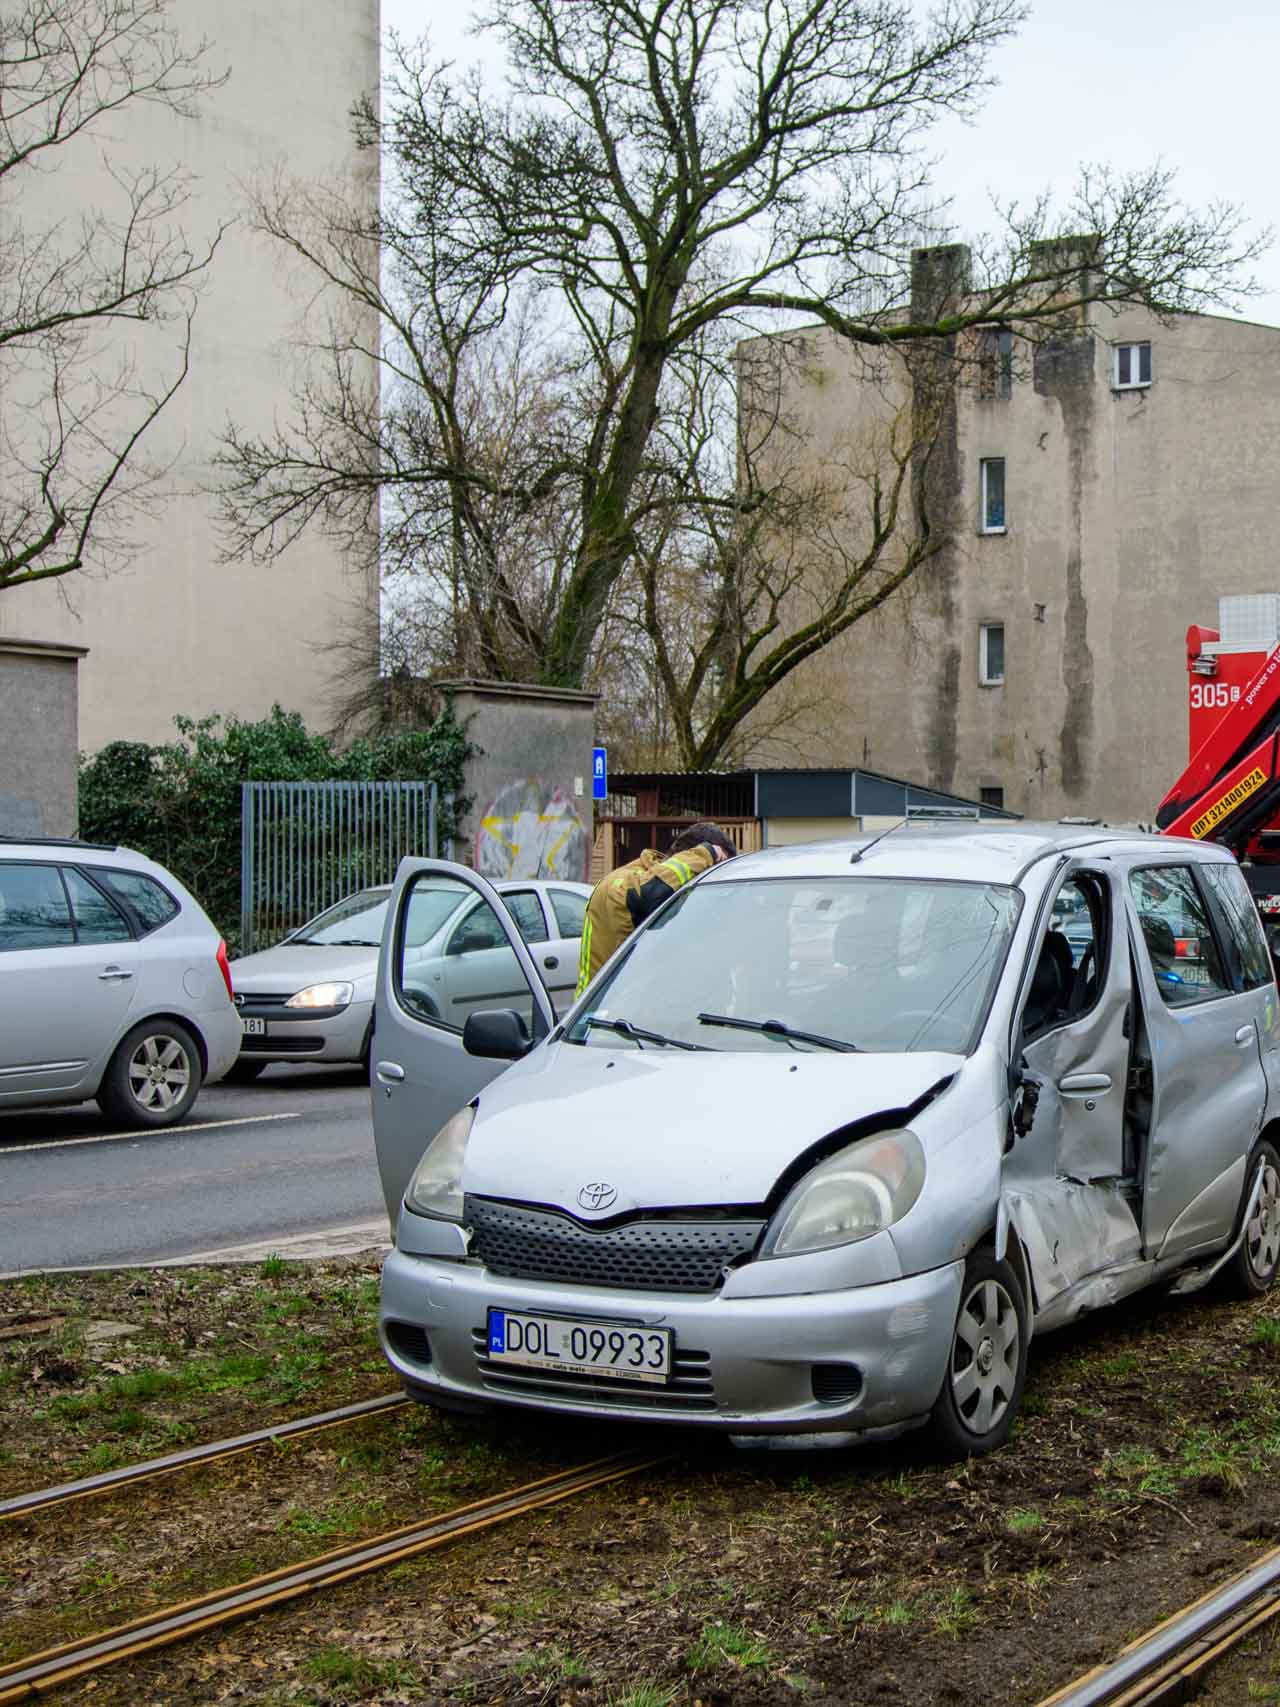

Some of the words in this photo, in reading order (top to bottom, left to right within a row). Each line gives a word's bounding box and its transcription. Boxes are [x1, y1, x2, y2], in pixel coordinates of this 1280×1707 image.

[1246, 672, 1268, 705] power
[1266, 662, 1277, 674] to
[492, 1337, 503, 1347] PL
[506, 1317, 561, 1358] DOL
[571, 1326, 665, 1369] 09933
